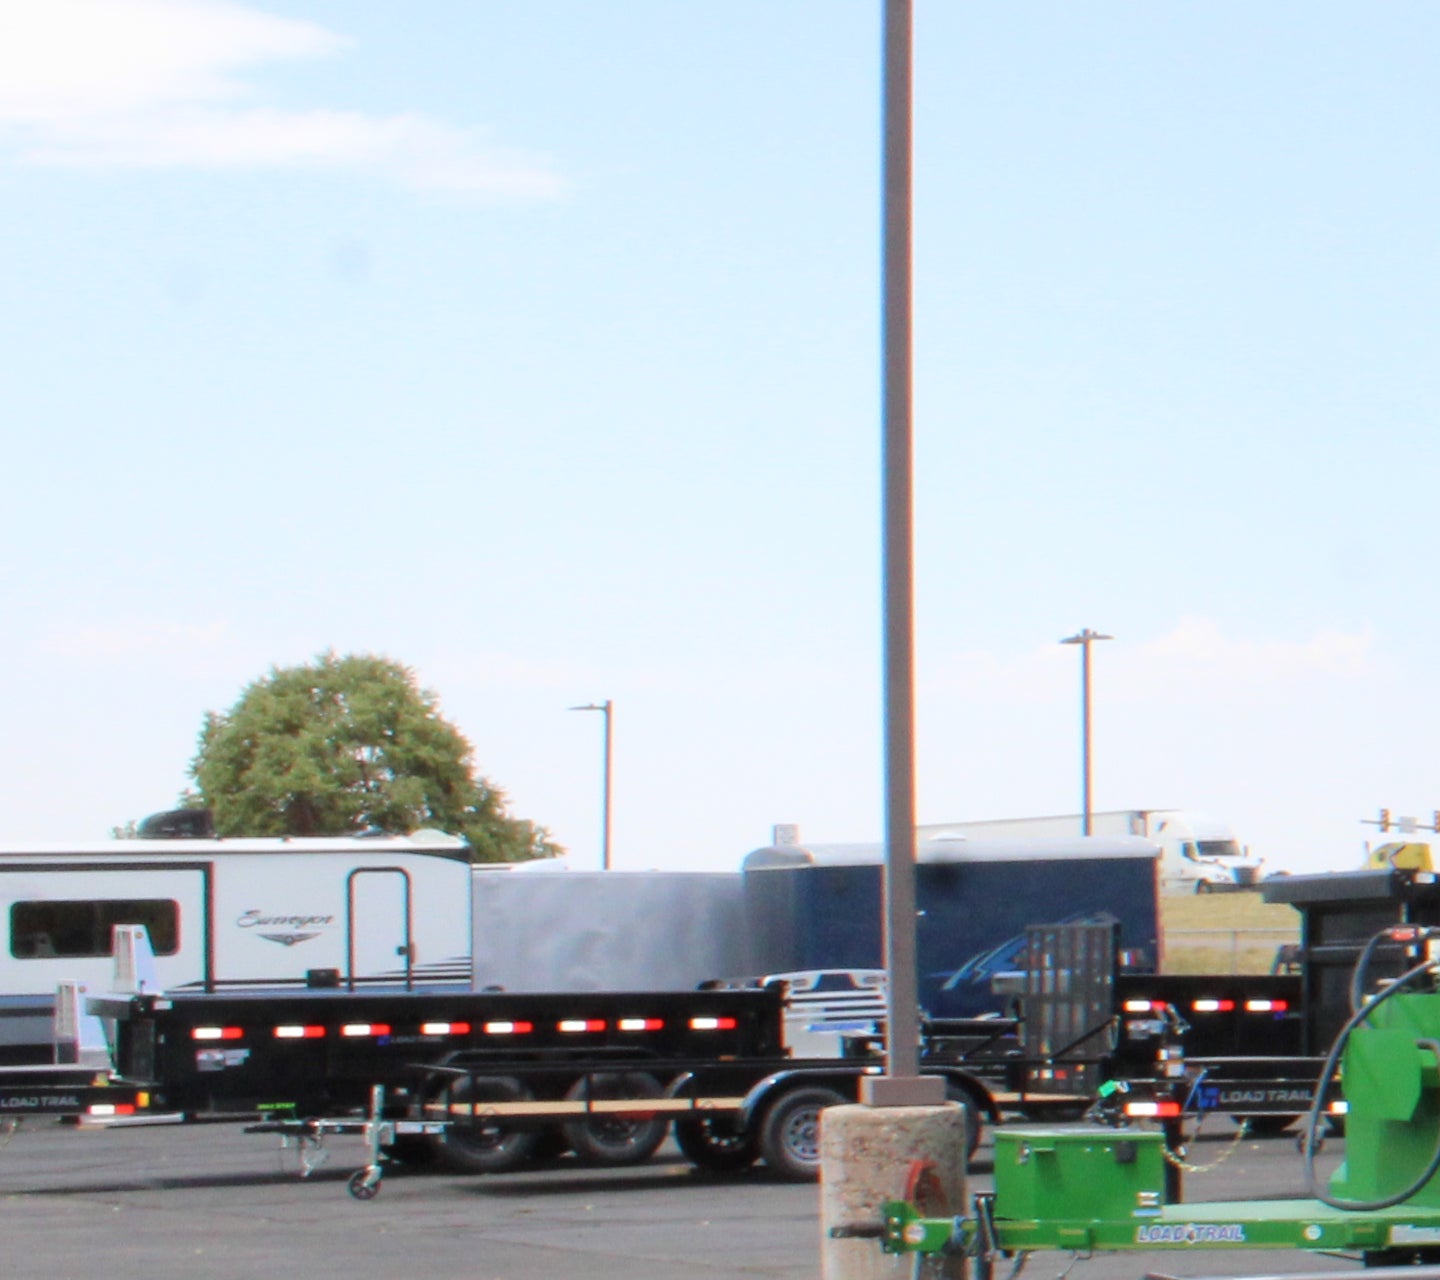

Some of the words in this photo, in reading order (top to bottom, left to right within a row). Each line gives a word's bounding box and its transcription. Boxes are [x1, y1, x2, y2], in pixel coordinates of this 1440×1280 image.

[237, 909, 335, 928] Surveyor
[0, 1097, 38, 1108] LOAD
[39, 1095, 80, 1106] TRAIL
[1220, 1091, 1266, 1103] LOAD
[1267, 1090, 1314, 1102] TRAIL
[1137, 1226, 1188, 1242] LOAD
[1191, 1224, 1245, 1241] TRAIL
